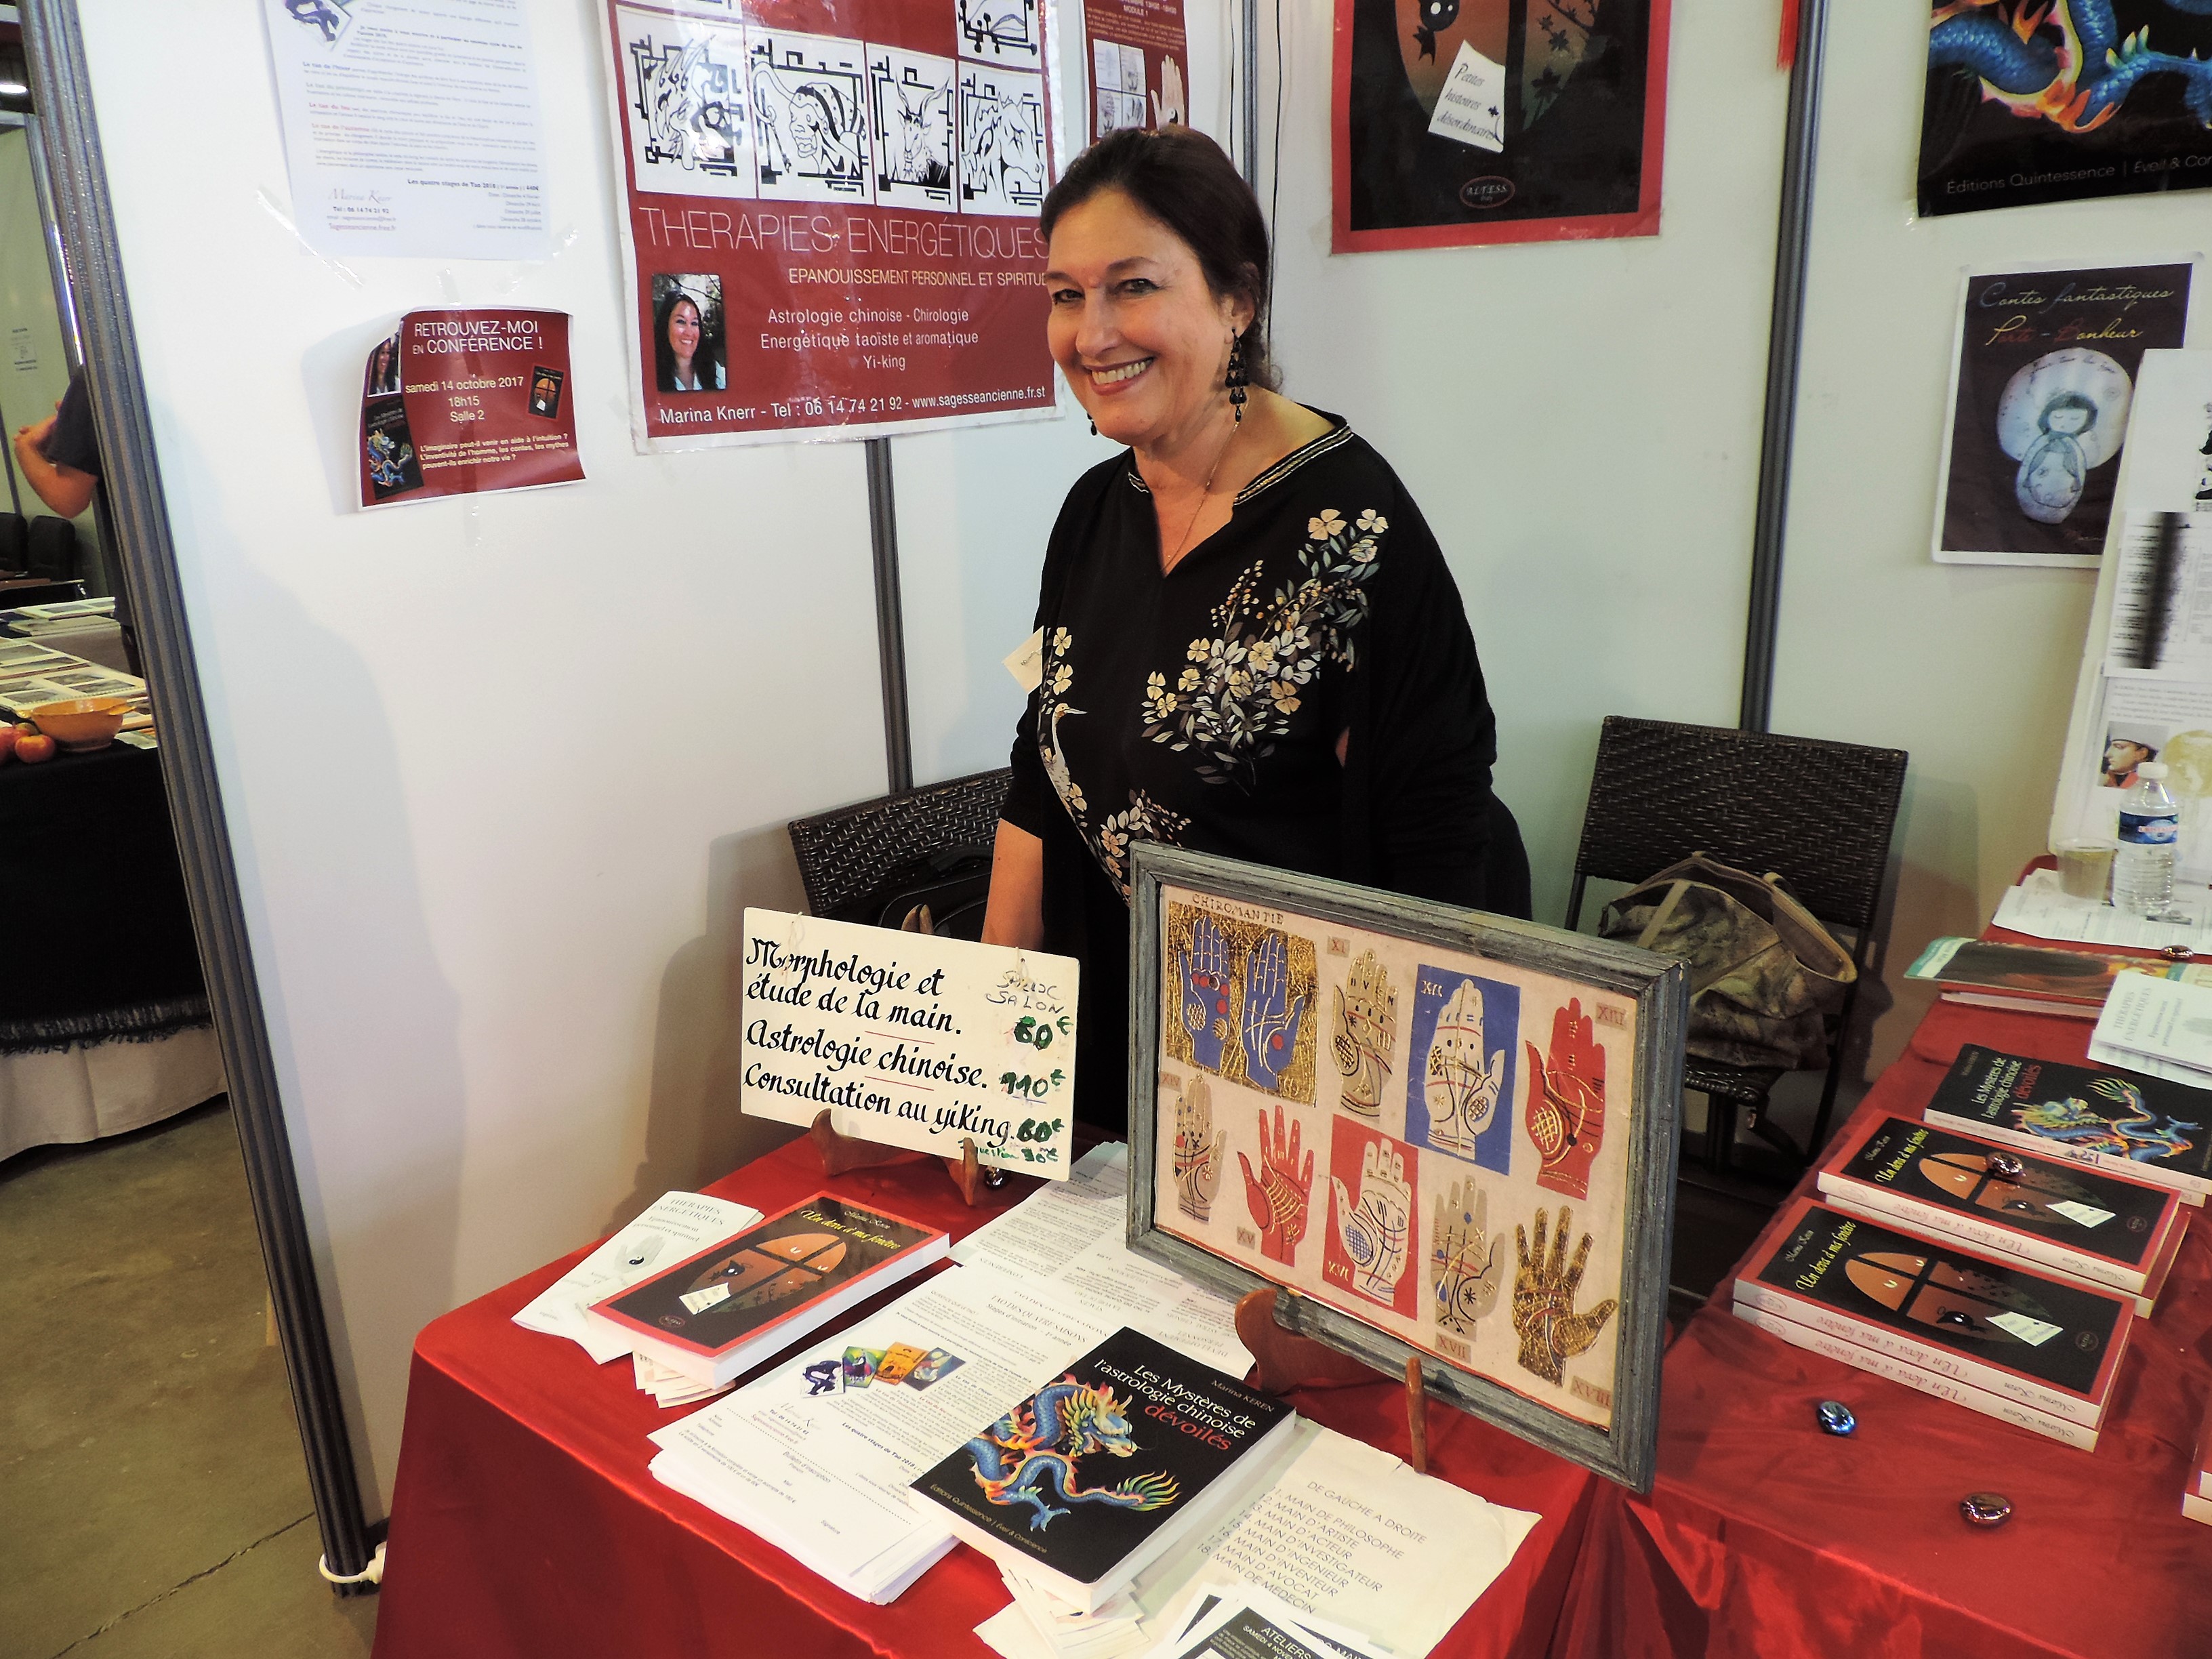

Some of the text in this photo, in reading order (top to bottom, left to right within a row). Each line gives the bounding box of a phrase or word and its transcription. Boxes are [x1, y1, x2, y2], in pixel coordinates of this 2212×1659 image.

[1454, 62, 1486, 87] Petites
[2010, 167, 2115, 188] Quintessence
[2171, 157, 2180, 169] &
[638, 207, 1049, 259] THERAPIES ENERGÉTIQUES
[790, 268, 909, 285] EPANOUISSEMENT
[912, 271, 975, 286] PERSONNEL
[979, 272, 993, 286] ET
[1980, 282, 2174, 314] Contes fantastiques
[415, 320, 538, 337] RETROUVEZ-MOI
[769, 308, 969, 327] Astrologie chinoise Chirologie
[412, 344, 424, 354] EN
[427, 335, 533, 354] CONFÉRENCE
[855, 332, 899, 346] taoïste
[903, 332, 912, 345] et
[916, 331, 979, 346] aromatique
[863, 354, 906, 371] Yi-king
[405, 376, 524, 394] samedi 14 octobre 2017
[448, 396, 480, 407] 18h15
[660, 386, 1046, 424] Marina Knerr Tel 06 14 74 21 92 www.sagesseancienne.fr.st
[450, 409, 485, 422] Salle 2
[1192, 893, 1284, 925] CHIROMANTIE
[1332, 939, 1346, 954] XI
[745, 938, 945, 996] Morphologie et
[746, 972, 962, 1034] étude de la main.
[985, 991, 1064, 1014] SALON
[746, 1020, 988, 1089] Astrologie chinoise.
[1971, 1094, 1988, 1104] Les
[1992, 1057, 2006, 1067] de
[1999, 1061, 2022, 1088] chinoise
[2013, 1065, 2041, 1099] dévoilés
[744, 1063, 890, 1115] Consultation
[897, 1099, 927, 1121] au
[1904, 1144, 1917, 1153] ma
[1237, 1231, 1254, 1244] XV
[1795, 1273, 1820, 1290] Un
[1828, 1240, 1843, 1253] ma
[1438, 1335, 1466, 1359] XVII
[1094, 1358, 1246, 1439] l'astrologie chinoise
[1133, 1364, 1256, 1429] Les Mystères de
[1211, 1379, 1275, 1413] Marina KEREN
[851, 1428, 867, 1439] quatre
[868, 1438, 884, 1449] stages
[1144, 1404, 1234, 1451] dévoilés
[1265, 1511, 1296, 1530] MAIN
[1275, 1502, 1306, 1521] MAIN
[1307, 1481, 1324, 1493] DE
[1324, 1490, 1374, 1517] GAUCHE
[1385, 1519, 1427, 1544] DROITE
[1244, 1528, 1276, 1547] MAIN
[1254, 1519, 1286, 1538] MAIN
[1286, 1494, 1316, 1513] MAIN
[1316, 1509, 1334, 1521] DE
[1333, 1517, 1404, 1559] PHILOSOPHE
[1223, 1545, 1256, 1565] MAIN
[1234, 1536, 1266, 1556] MAIN
[1212, 1553, 1246, 1574] MAIN
[1244, 1571, 1263, 1584] DE
[1261, 1580, 1316, 1614] MEDECIN
[1243, 1625, 1267, 1644] SAMEDI
[1261, 1626, 1312, 1659] ATELIERS
